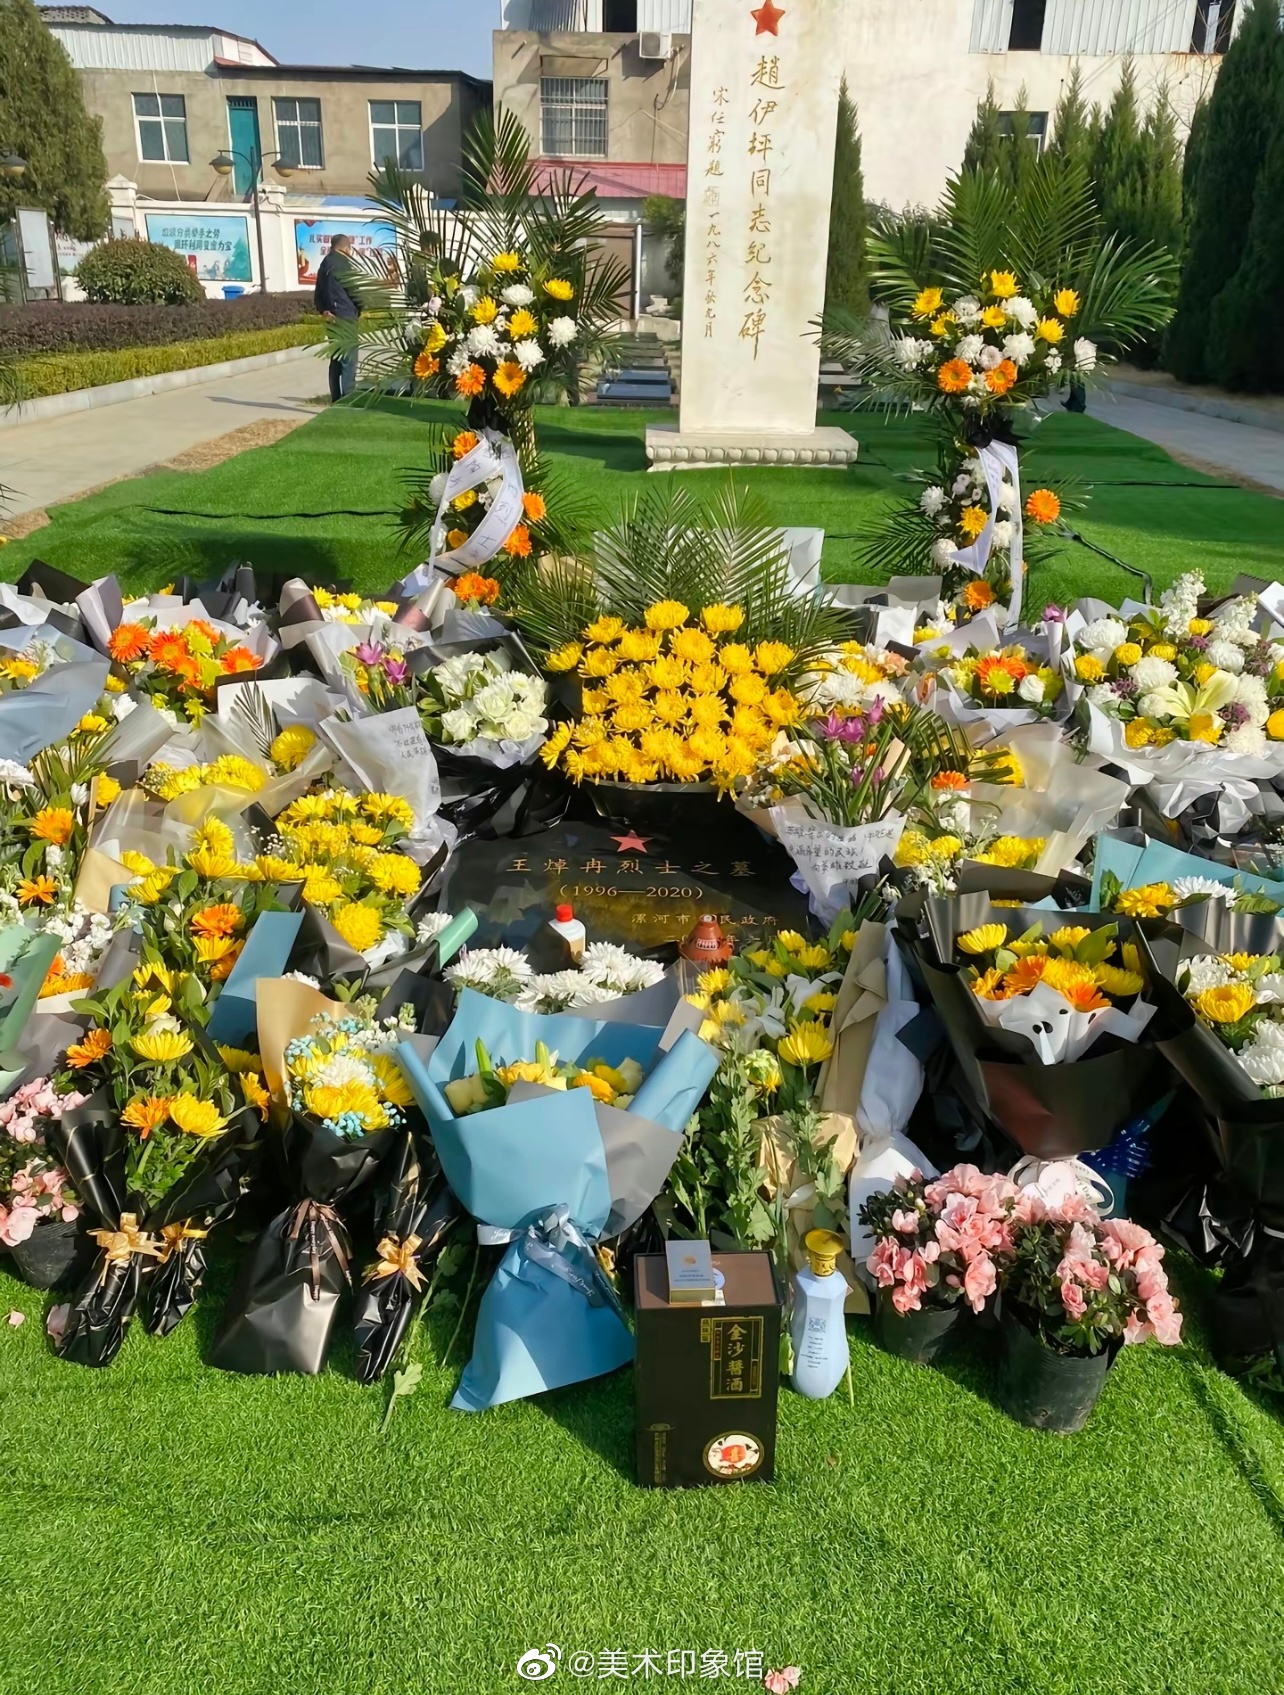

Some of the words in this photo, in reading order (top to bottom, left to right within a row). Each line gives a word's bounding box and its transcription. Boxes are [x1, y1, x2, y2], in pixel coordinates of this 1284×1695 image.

[506, 858, 757, 877] 王焯冉烈士之墓
[631, 913, 780, 926] 漯河市民政府
